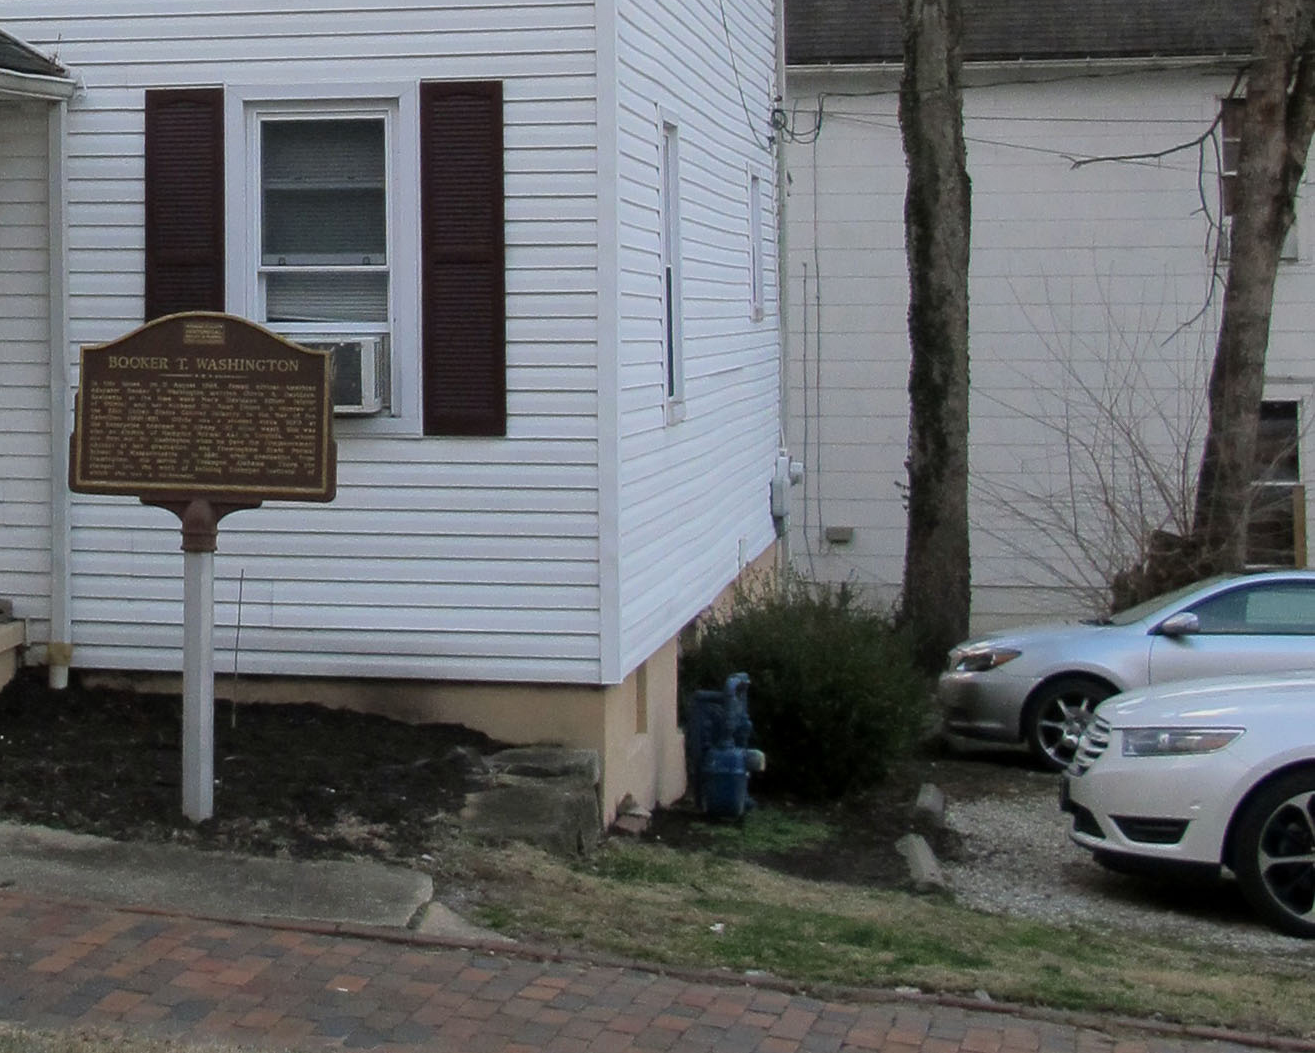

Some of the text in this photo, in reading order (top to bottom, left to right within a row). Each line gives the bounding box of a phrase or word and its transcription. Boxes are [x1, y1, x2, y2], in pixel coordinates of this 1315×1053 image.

[108, 355, 299, 372] BOOKER T. WASHINGTON
